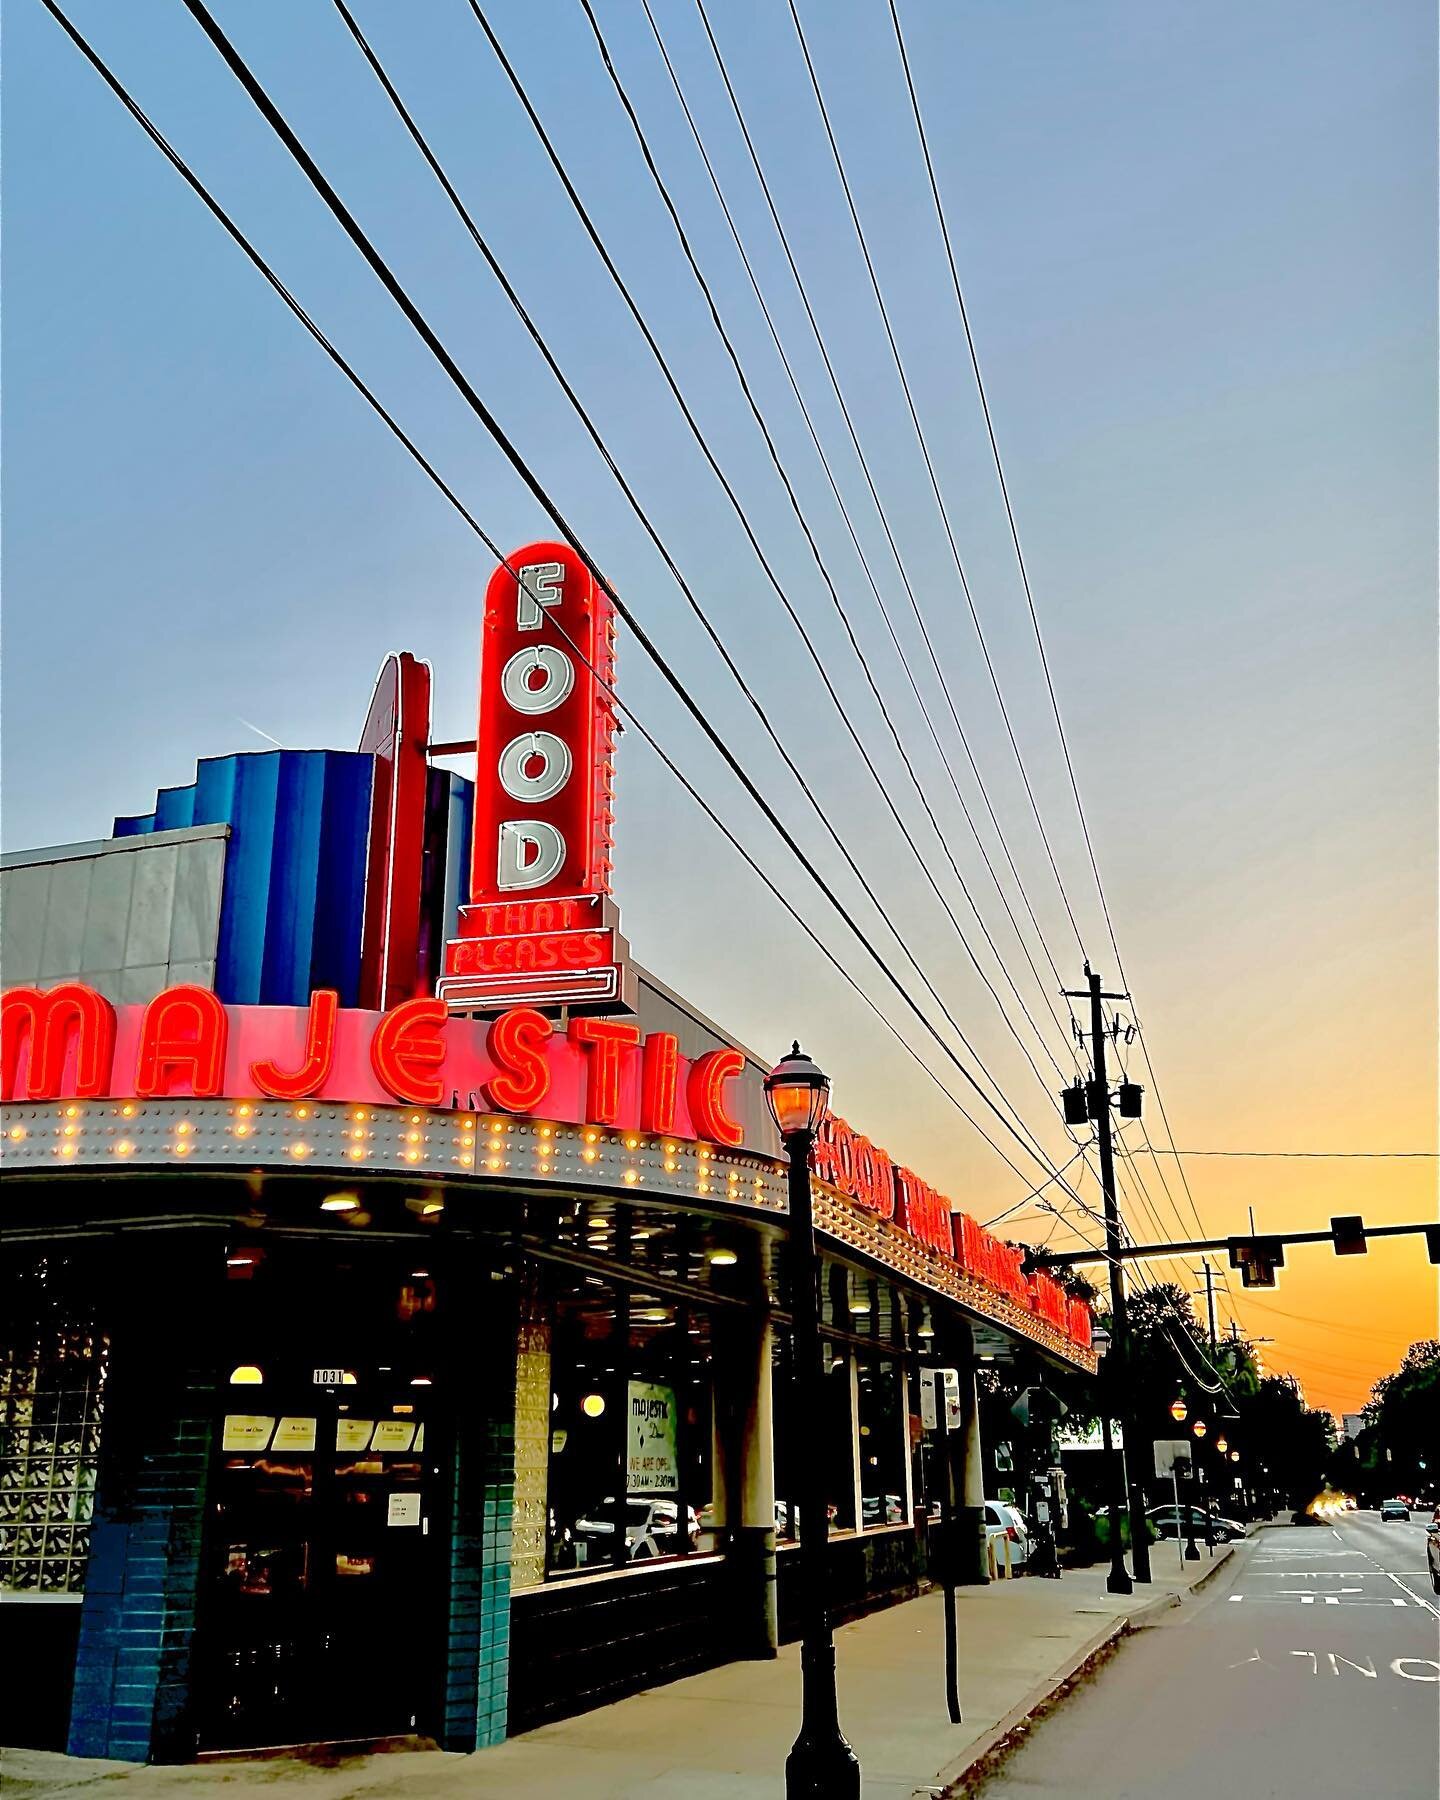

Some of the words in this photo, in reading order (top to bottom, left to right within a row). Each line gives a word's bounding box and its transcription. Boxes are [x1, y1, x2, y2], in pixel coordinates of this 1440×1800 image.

[498, 562, 575, 893] FOOD
[481, 900, 578, 935] THAT
[453, 934, 603, 974] PLEASES
[0, 983, 745, 1147] MAJESTIC
[316, 1370, 342, 1383] 1031
[630, 1456, 640, 1470] WE
[643, 1456, 654, 1470] ARE
[1227, 1648, 1440, 1682] ONLY
